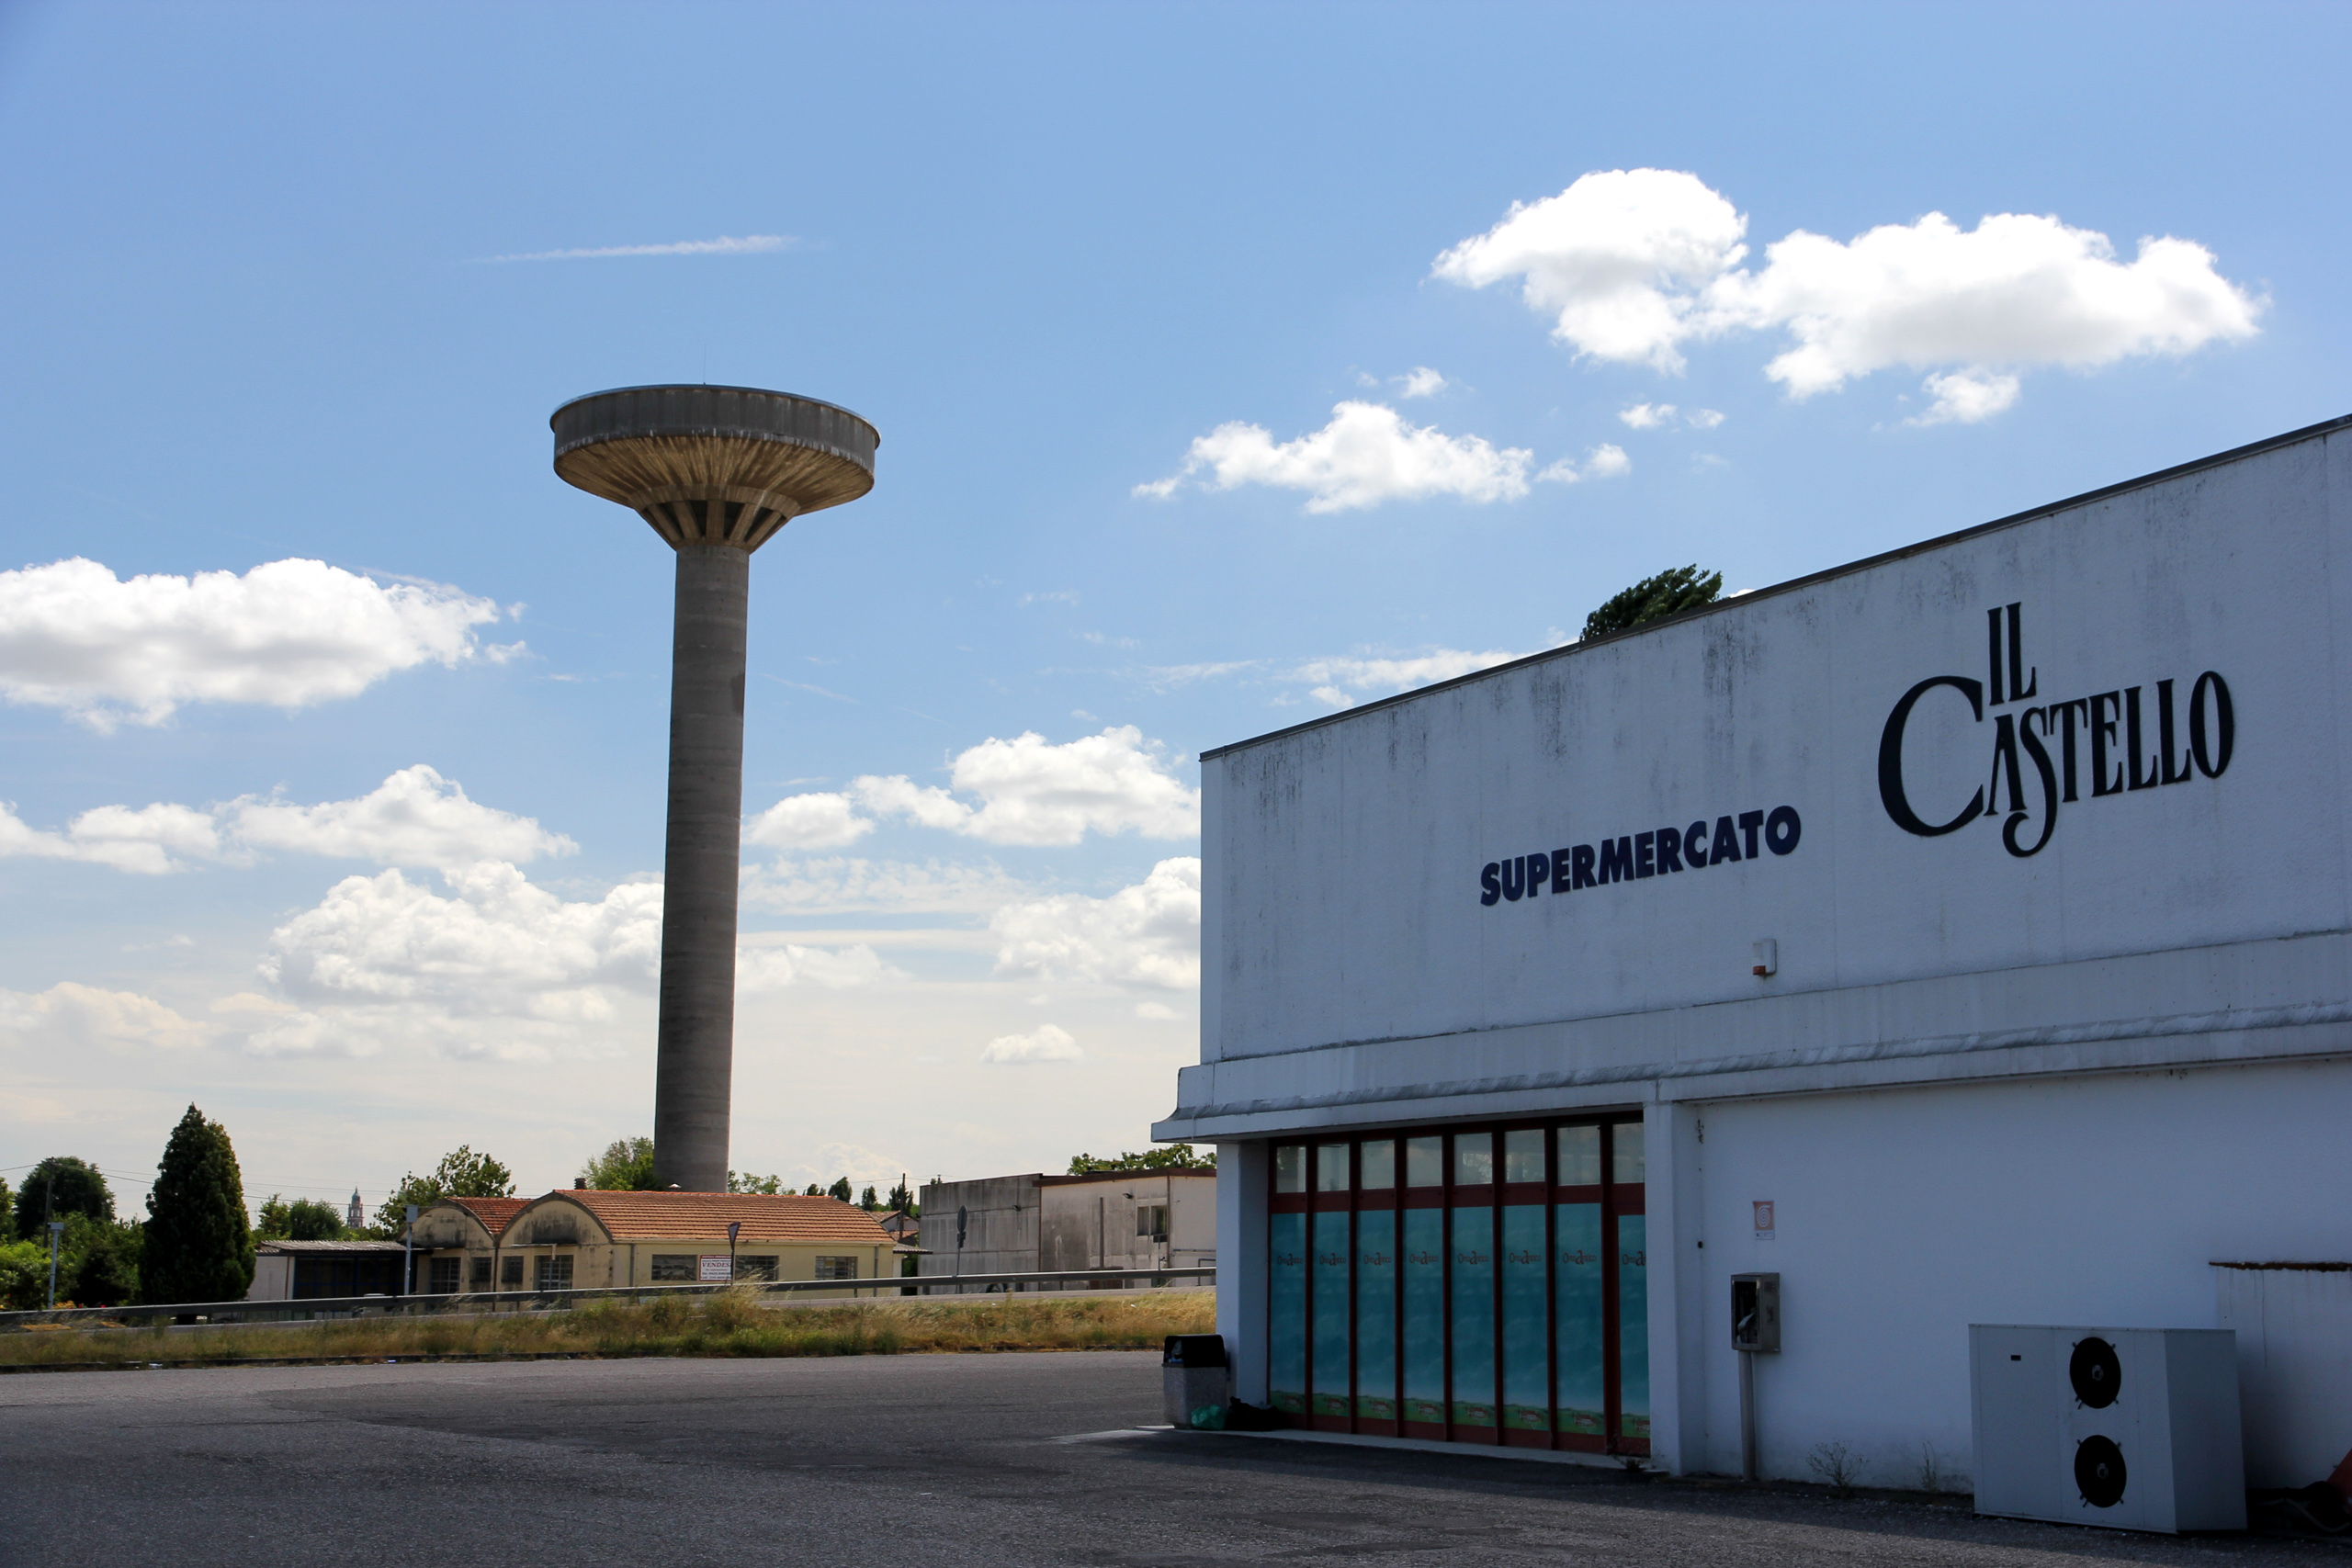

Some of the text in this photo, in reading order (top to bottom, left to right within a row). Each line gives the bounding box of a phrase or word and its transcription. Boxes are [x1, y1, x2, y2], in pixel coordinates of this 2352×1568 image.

[1986, 601, 2037, 706] IL
[1877, 670, 2235, 858] CASTELLO
[1480, 805, 1802, 907] SUPERMERCATO
